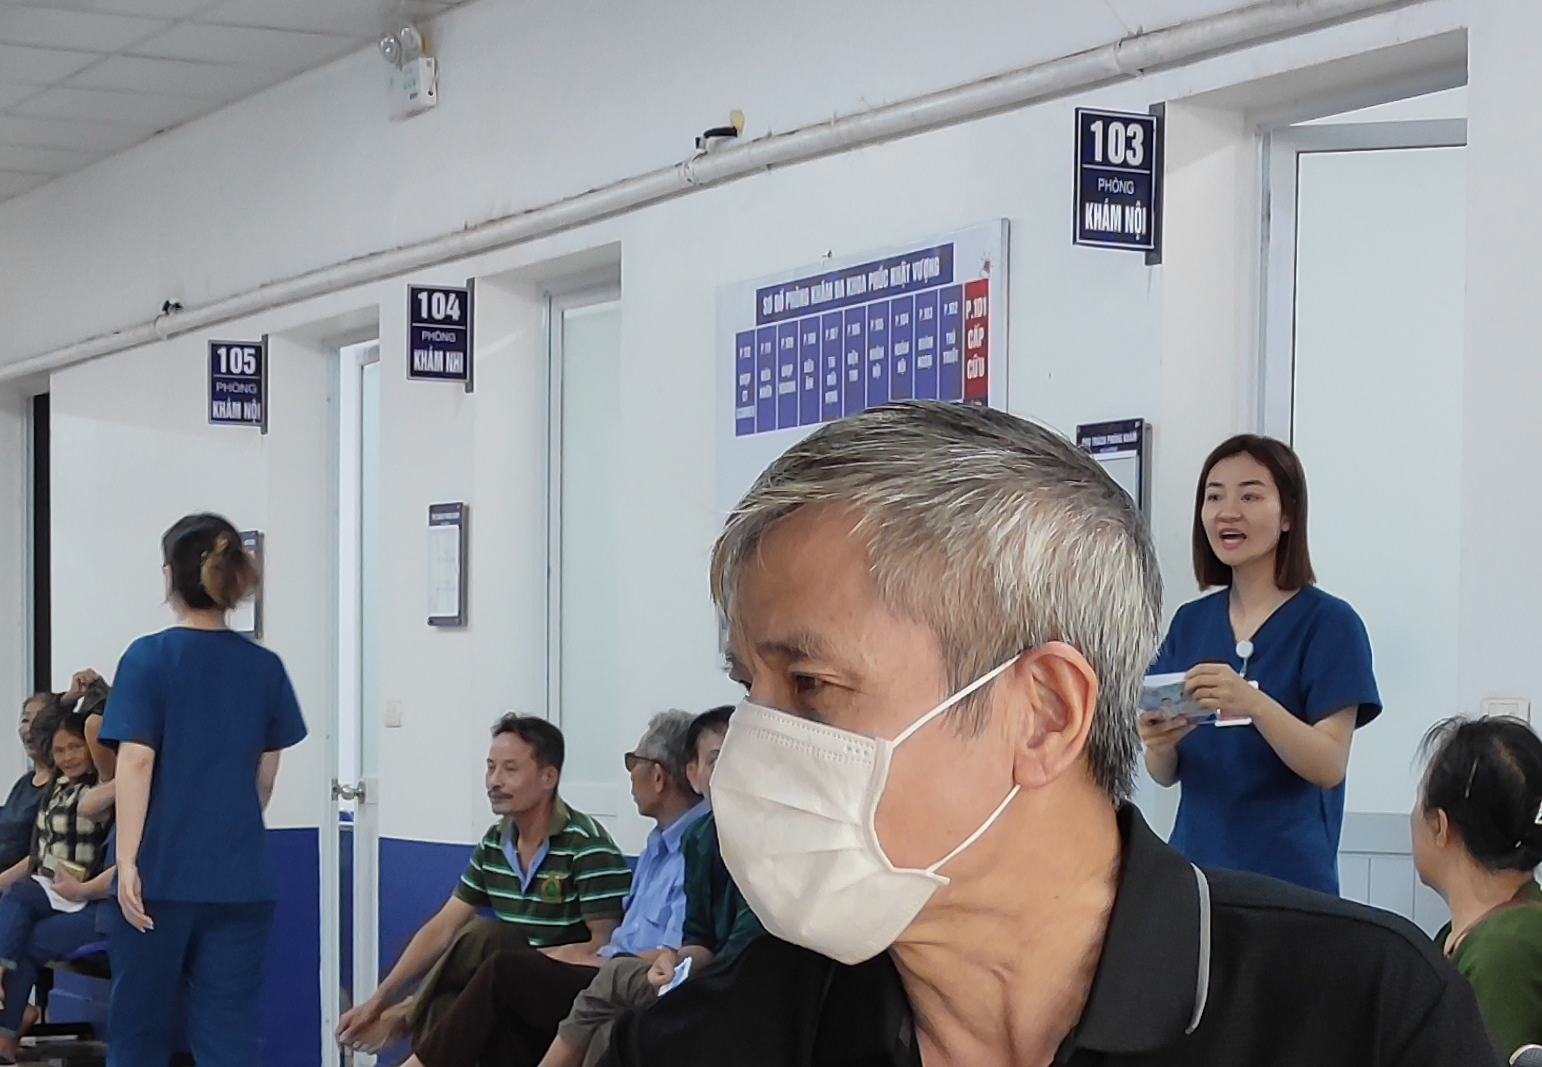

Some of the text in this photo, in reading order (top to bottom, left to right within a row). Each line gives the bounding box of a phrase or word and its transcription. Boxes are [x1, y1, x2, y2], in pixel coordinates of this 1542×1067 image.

[1090, 120, 1144, 166] 103
[1098, 177, 1134, 194] PHÒNG
[1085, 198, 1147, 240] KHÁM NỘI
[418, 291, 461, 321] 104
[421, 330, 456, 342] PHÒNG
[217, 347, 256, 374] 105
[414, 344, 463, 373] KHÁM NHI
[216, 382, 257, 394] PHÒNG
[212, 396, 261, 424] KHÁM NỘI
